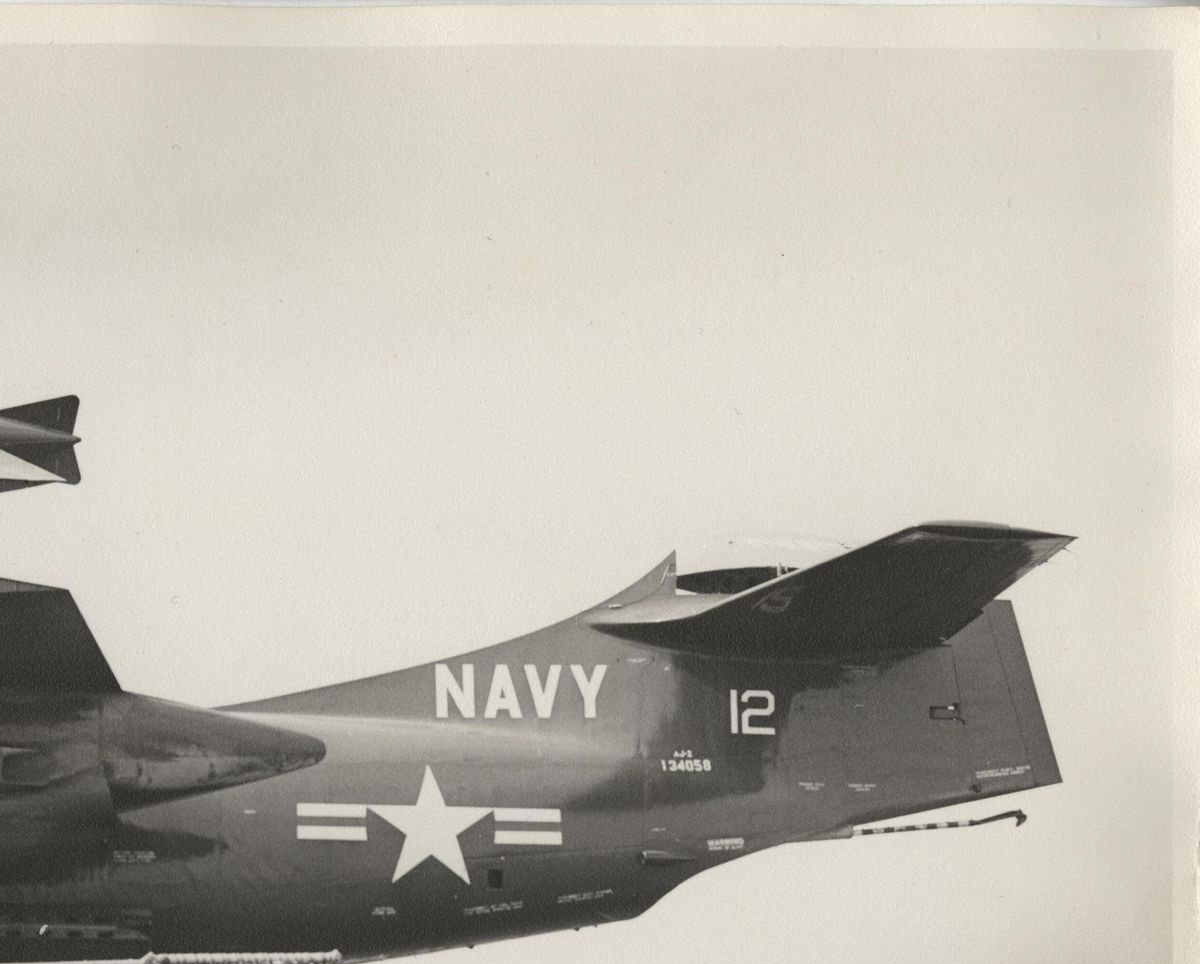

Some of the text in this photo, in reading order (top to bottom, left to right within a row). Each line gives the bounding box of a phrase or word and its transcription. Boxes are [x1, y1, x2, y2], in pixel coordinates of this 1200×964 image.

[434, 663, 608, 719] NAVY
[730, 689, 776, 735] 12
[661, 758, 712, 772] 134058
